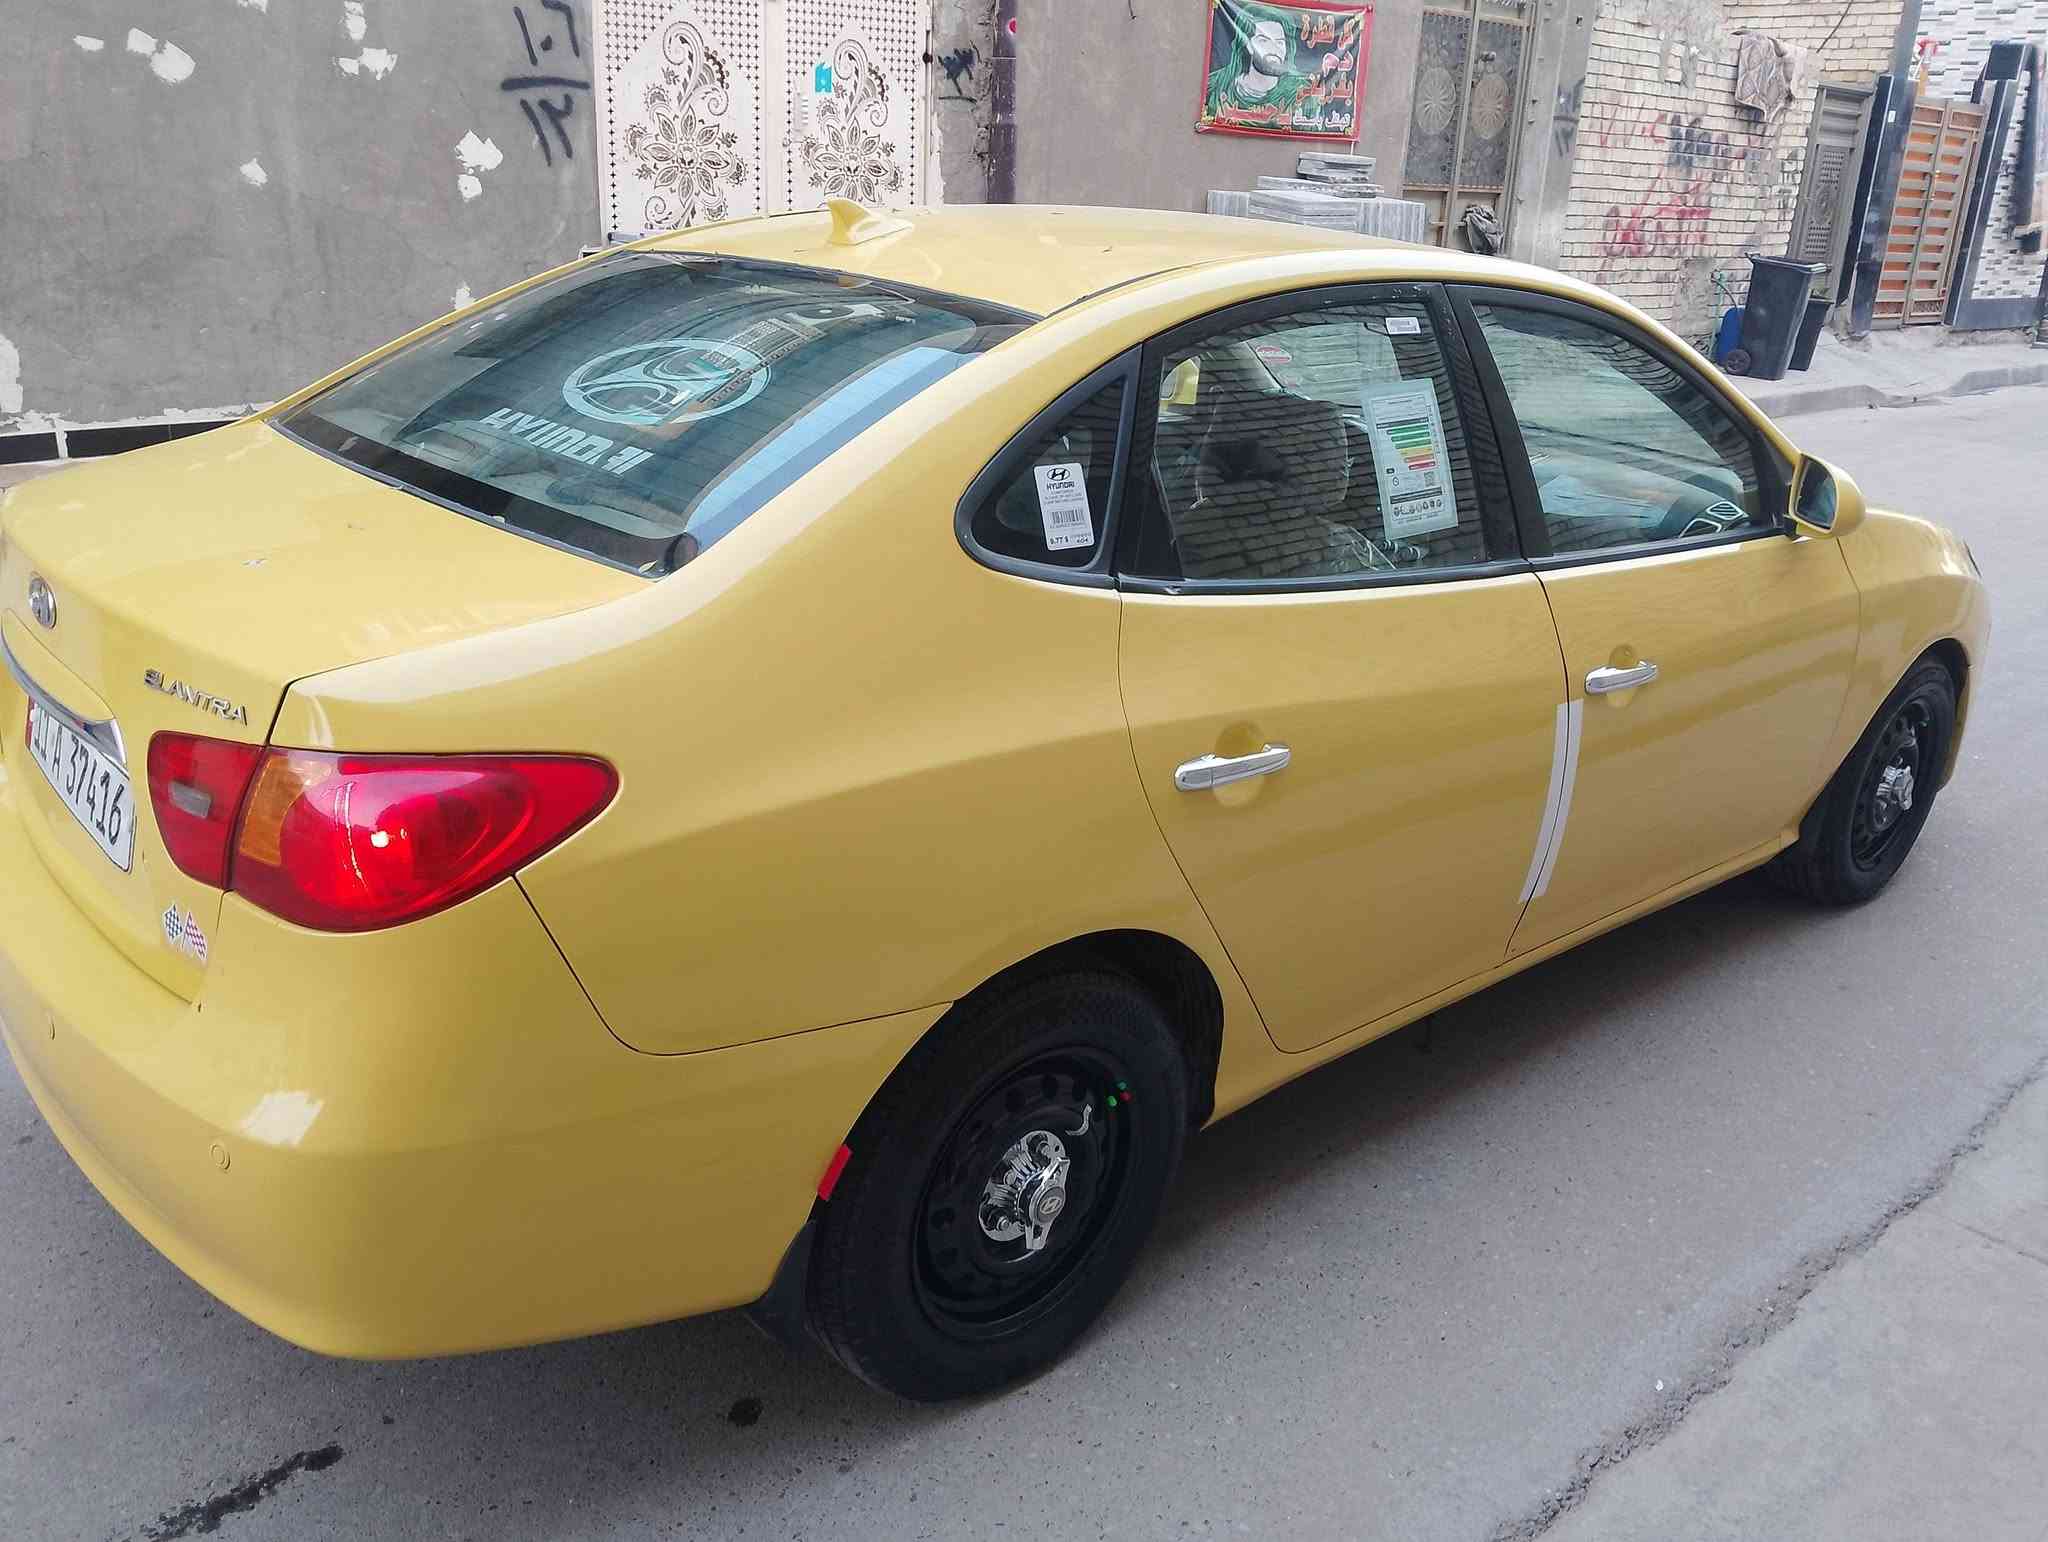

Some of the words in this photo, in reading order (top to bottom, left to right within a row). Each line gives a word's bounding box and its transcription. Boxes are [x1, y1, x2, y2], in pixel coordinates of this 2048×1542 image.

[1047, 481, 1075, 490] HYUNDAI
[144, 668, 248, 726] ELANTRA
[66, 736, 124, 845] 37416
